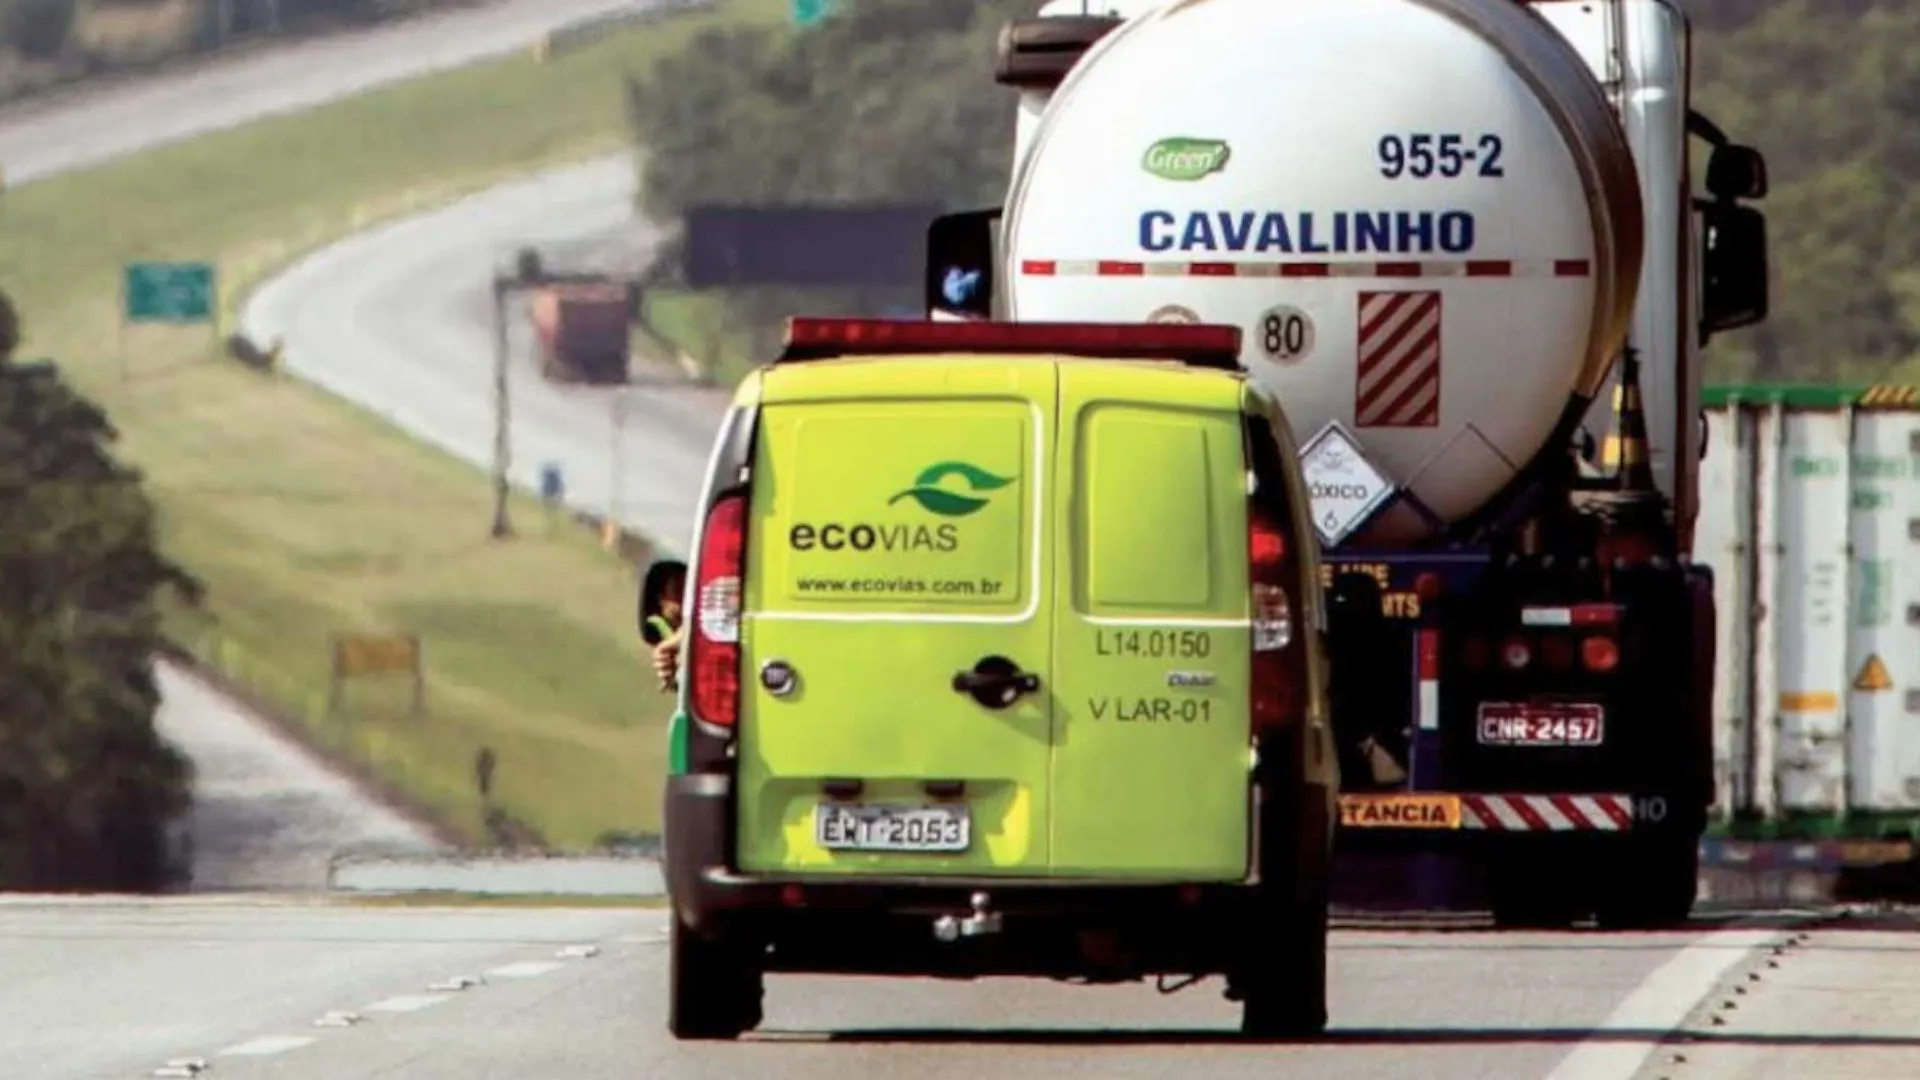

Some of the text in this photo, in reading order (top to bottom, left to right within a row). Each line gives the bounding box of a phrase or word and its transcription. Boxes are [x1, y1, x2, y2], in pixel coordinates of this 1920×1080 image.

[1378, 134, 1504, 179] 955-2
[1139, 210, 1475, 253] CAVALINHO
[1265, 315, 1303, 354] 80
[1310, 481, 1368, 499] ÓXICO
[1324, 509, 1339, 531] 6
[790, 523, 958, 551] ecoVIAS
[797, 576, 1002, 596] www.ecovias.com.br
[1096, 629, 1211, 658] L14.0150
[1088, 697, 1212, 723] V LAR-01
